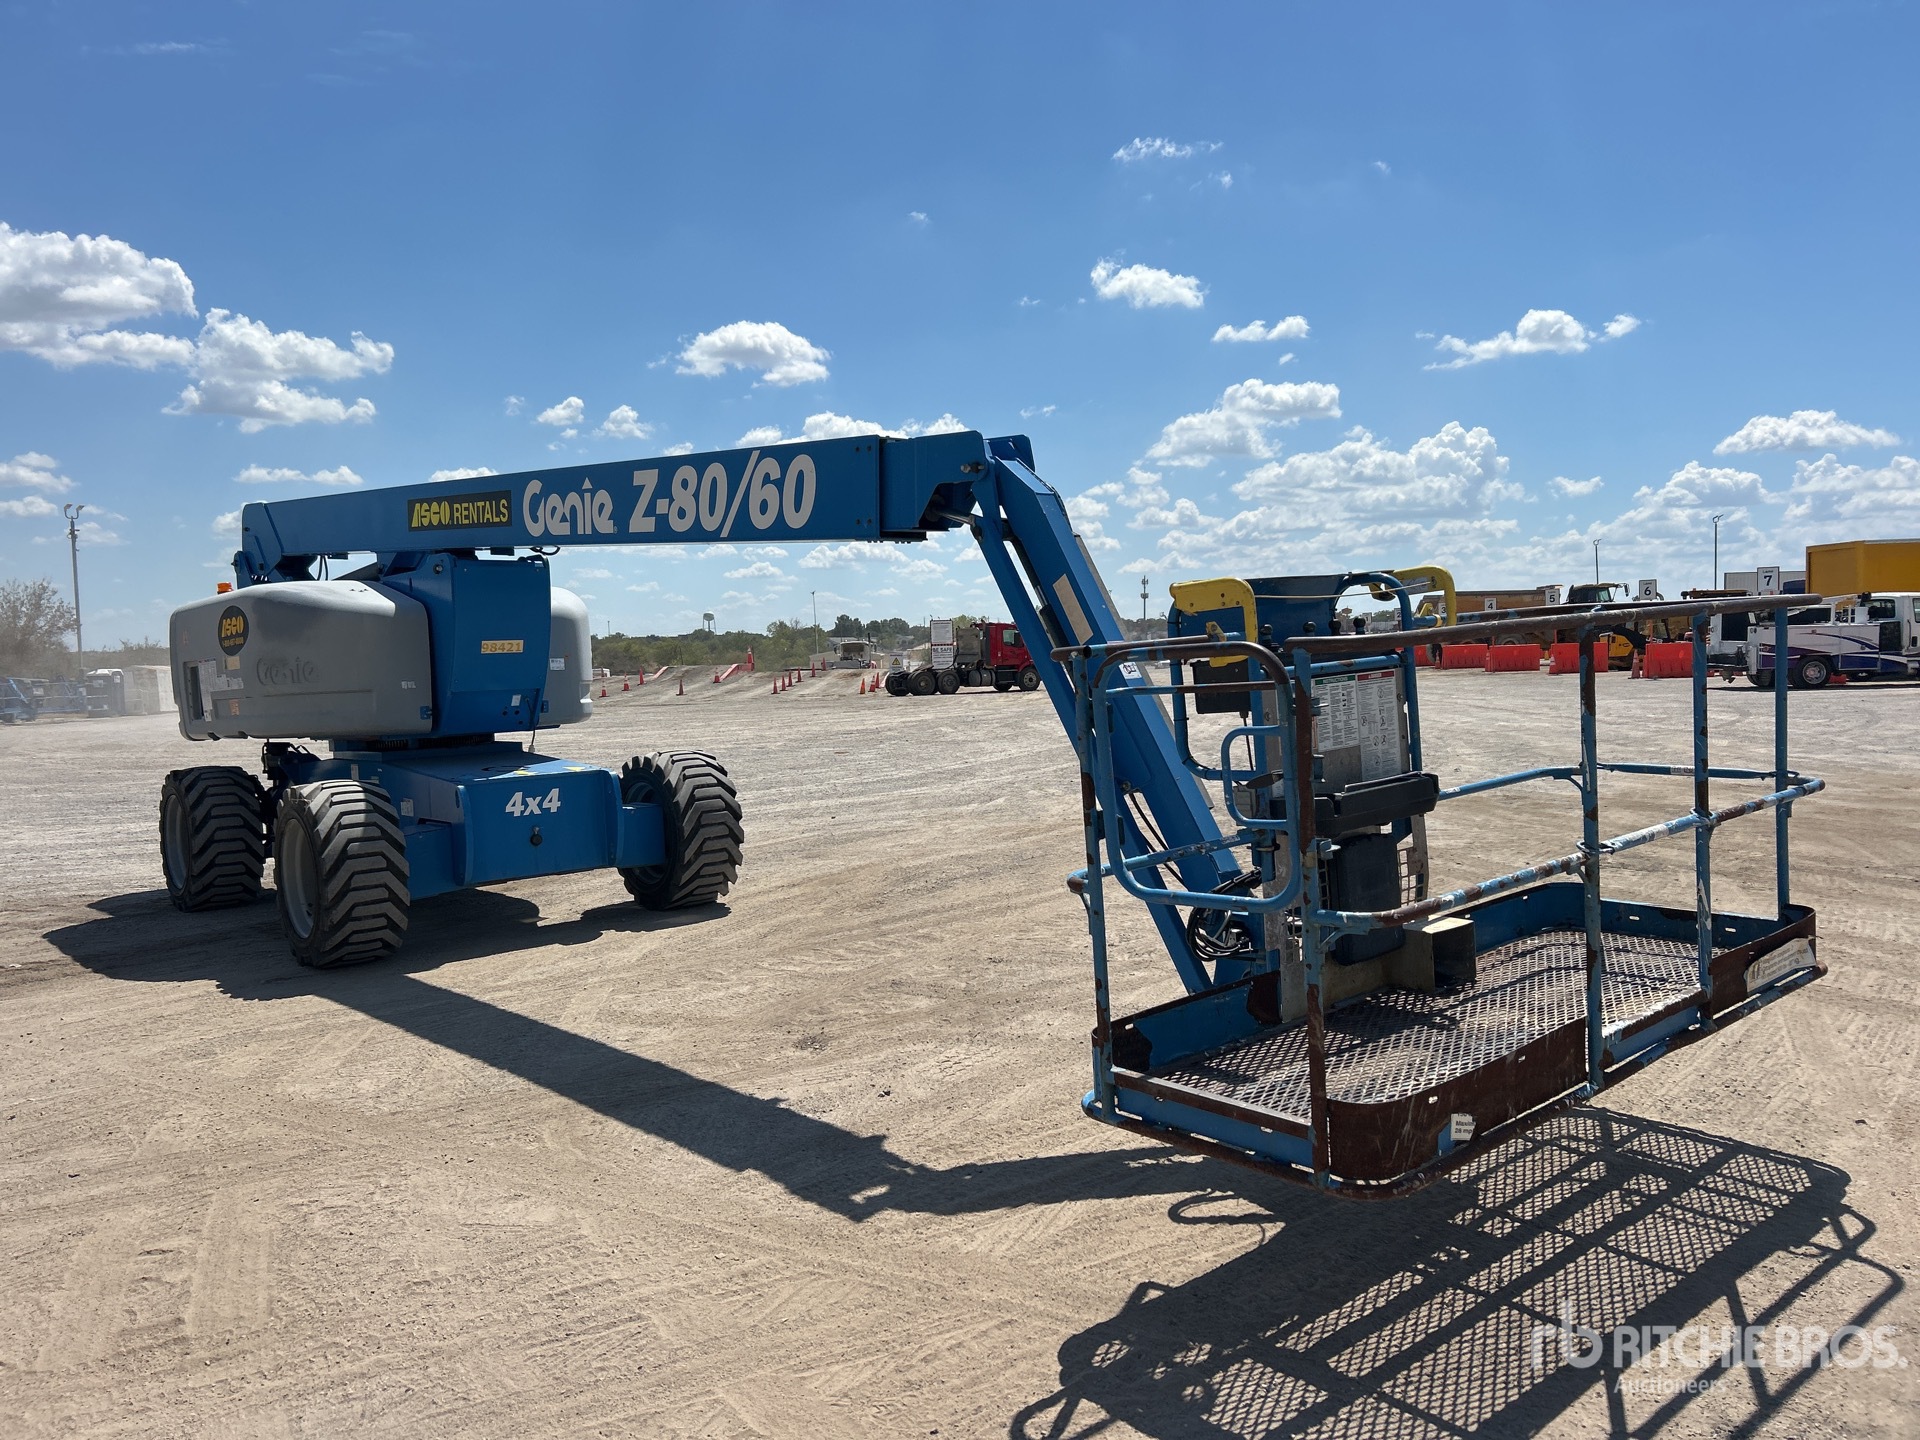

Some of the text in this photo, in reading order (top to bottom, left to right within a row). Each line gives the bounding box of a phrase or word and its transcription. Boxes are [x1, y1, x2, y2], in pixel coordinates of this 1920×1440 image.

[523, 450, 816, 538] Genie Z-80/60
[411, 499, 508, 528] ASCO RENTALS
[1764, 575, 1772, 586] 7
[1644, 586, 1652, 596] 6
[1549, 594, 1555, 602] 5
[1487, 602, 1493, 610] 4
[482, 642, 521, 652] 98421
[505, 788, 561, 817] 4x4
